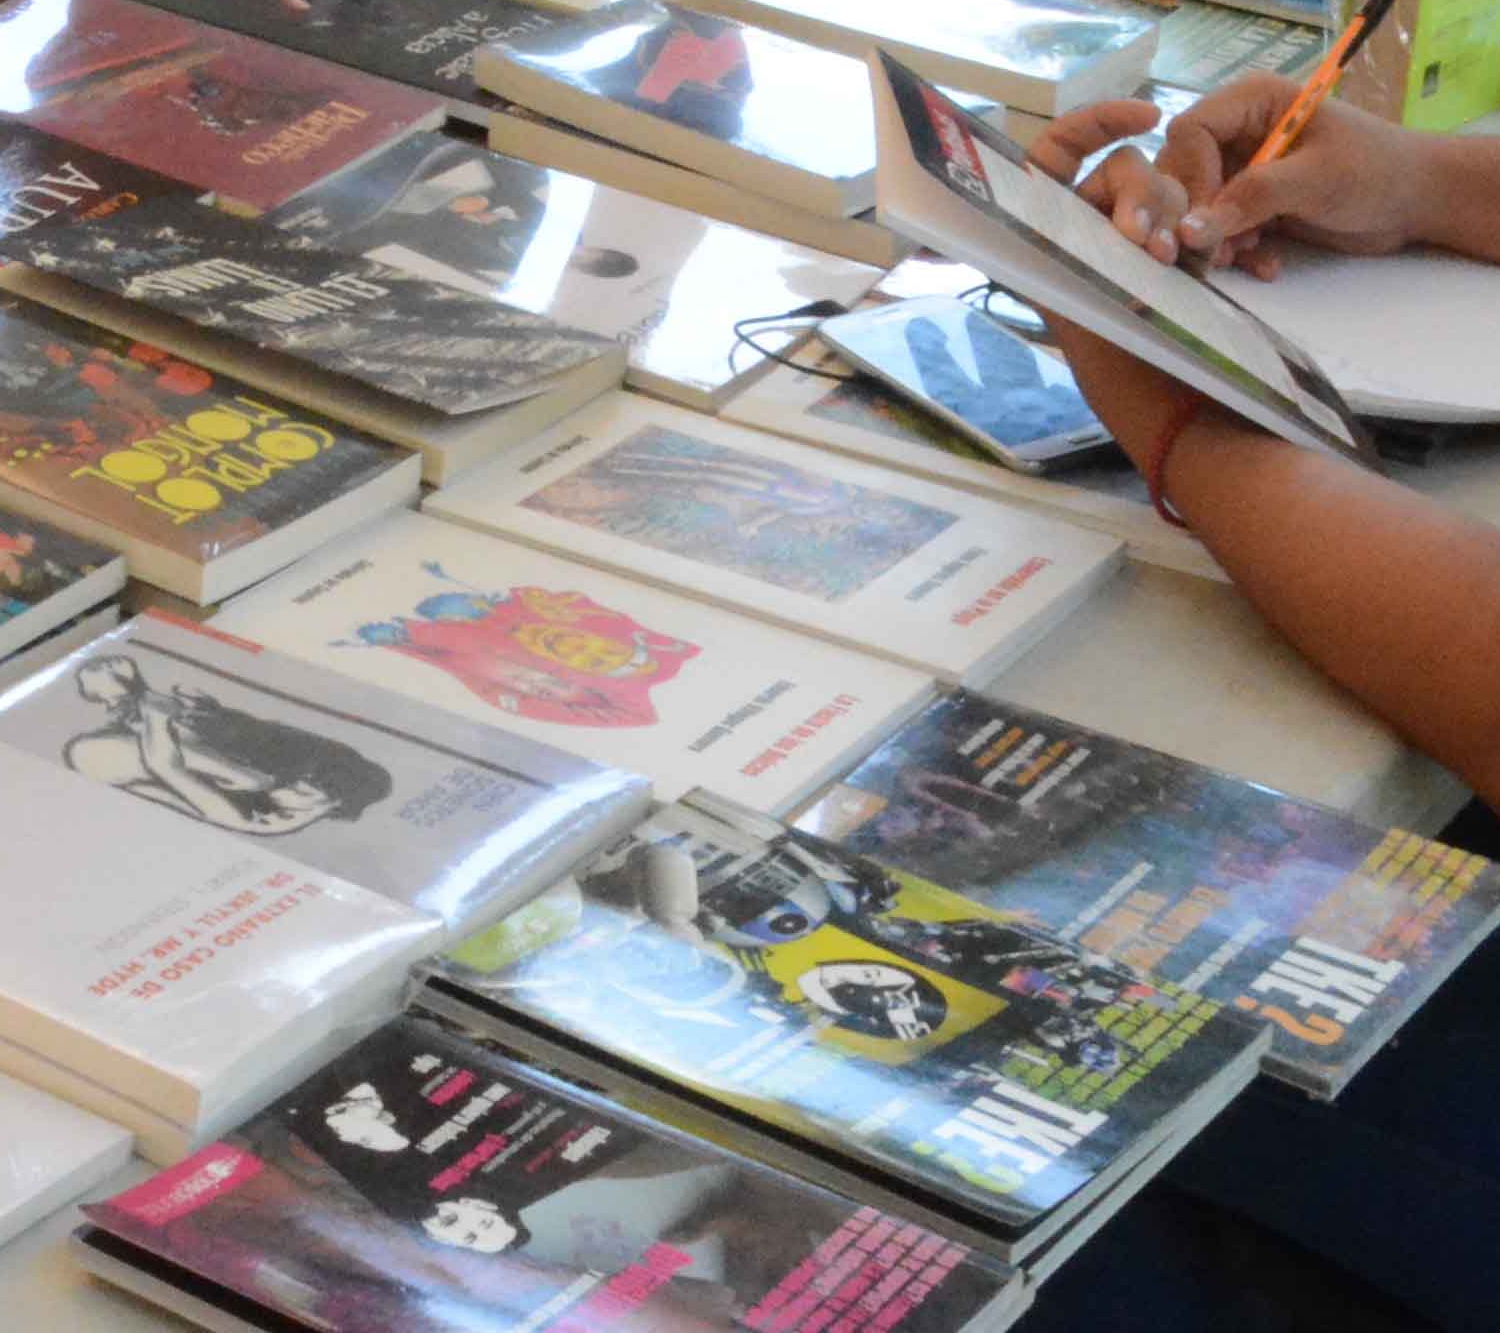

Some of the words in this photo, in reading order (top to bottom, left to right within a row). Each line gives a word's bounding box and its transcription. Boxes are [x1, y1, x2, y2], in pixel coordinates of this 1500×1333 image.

[63, 392, 290, 501] MONGOL
[122, 416, 348, 528] COMPLOT
[190, 887, 264, 930] JEKYLL
[80, 959, 149, 999] HYDE
[152, 943, 223, 984] CASO
[124, 978, 168, 1002] DE
